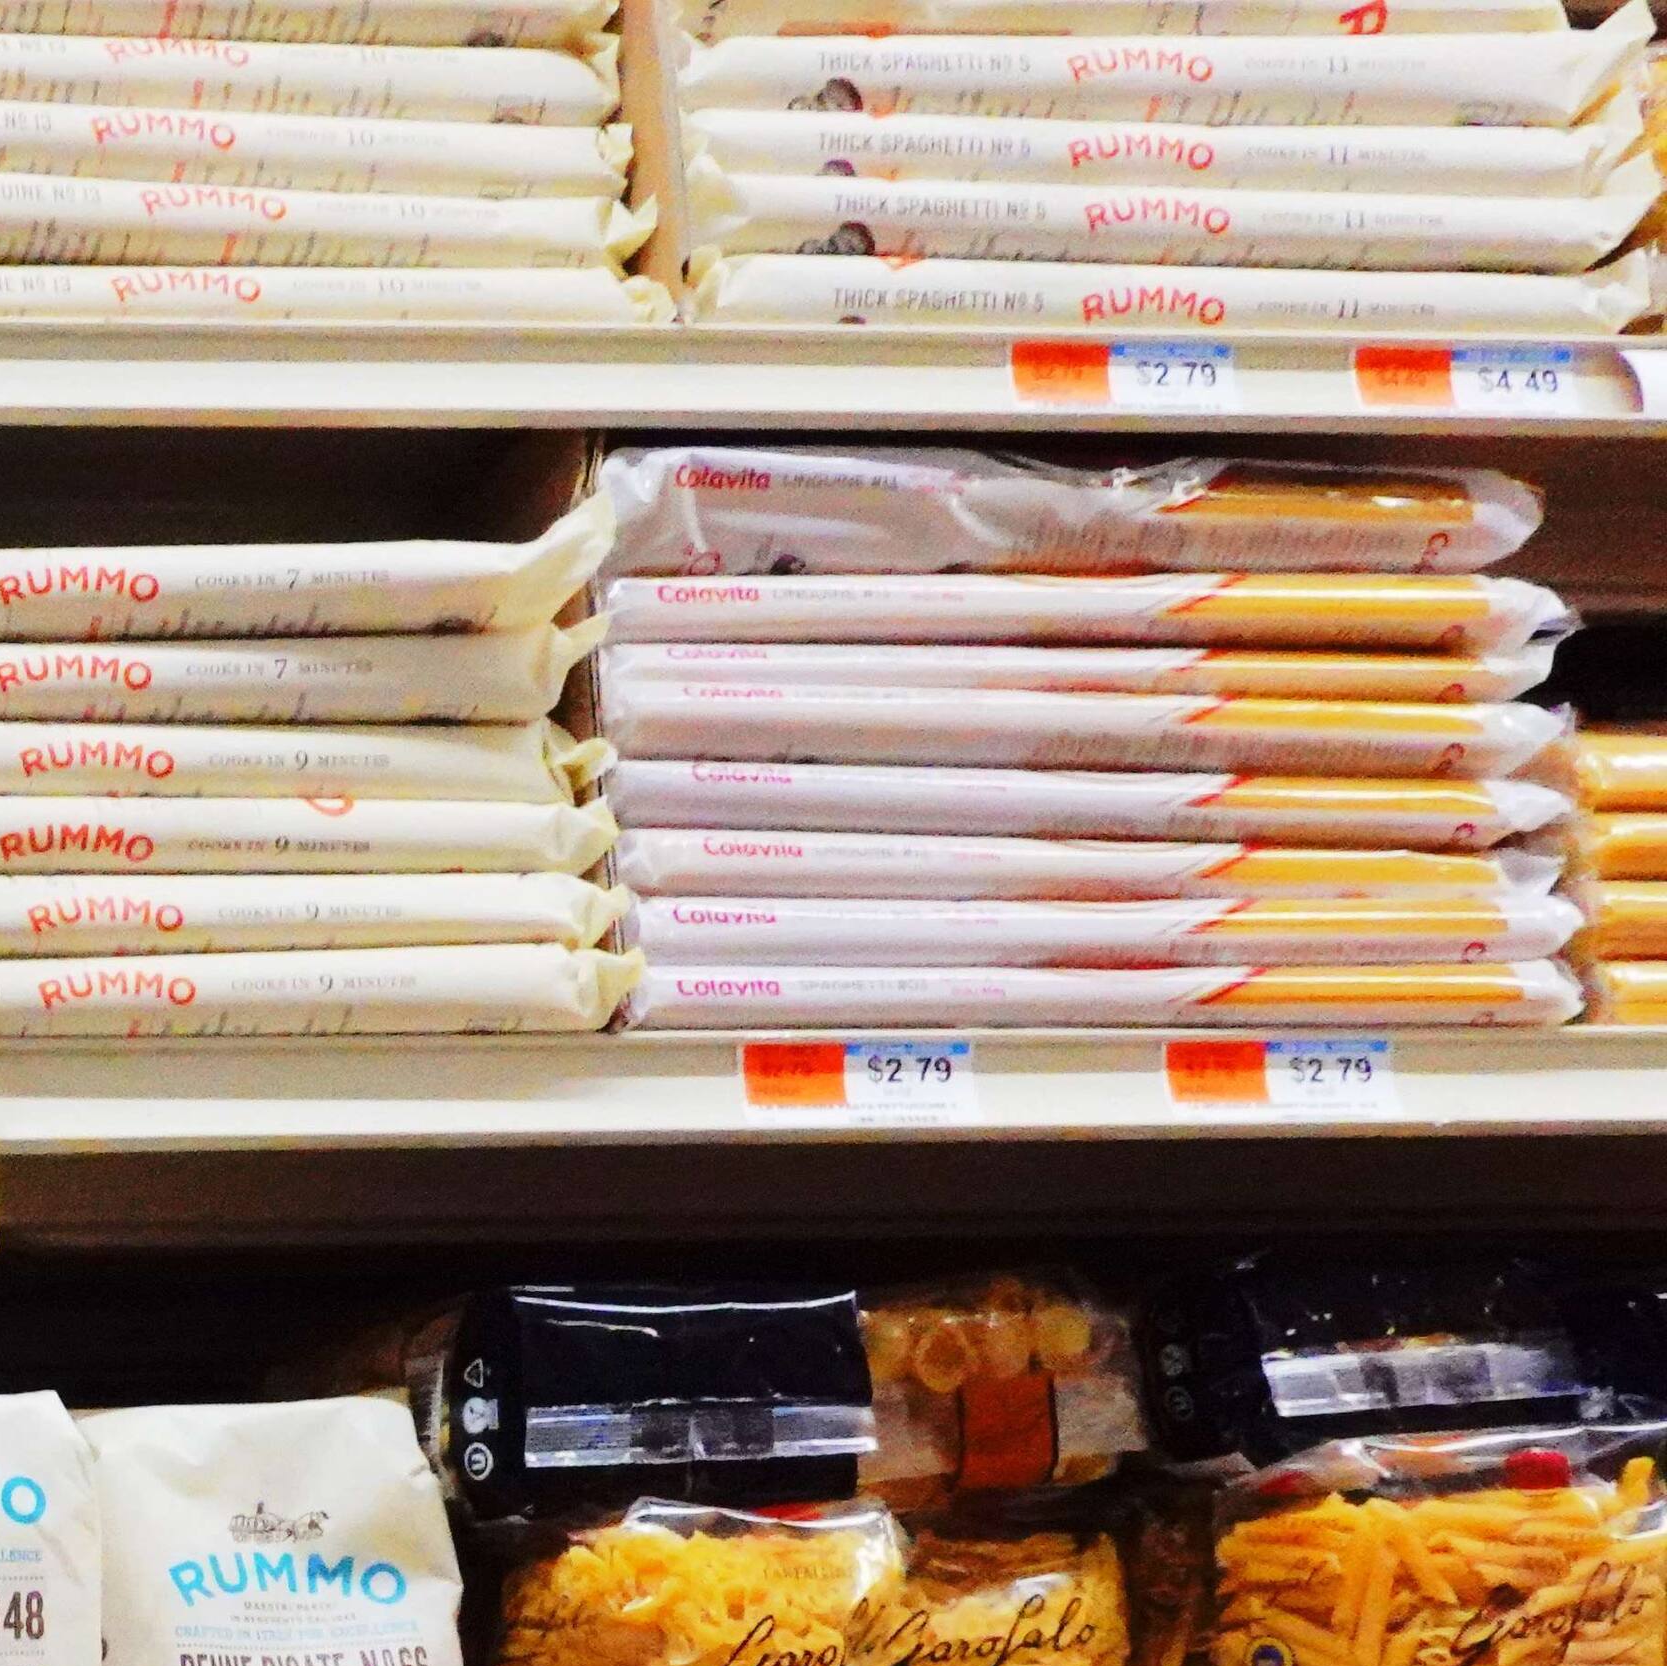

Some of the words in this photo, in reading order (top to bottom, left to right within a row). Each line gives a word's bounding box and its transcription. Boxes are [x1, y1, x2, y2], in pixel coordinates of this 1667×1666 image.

[833, 287, 888, 310] THICK
[1081, 286, 1226, 326] RUMMO
[674, 465, 771, 490] Colavita
[20, 740, 175, 778] RUMMO
[676, 977, 781, 997] Colavita
[168, 1552, 408, 1608] RUMMO
